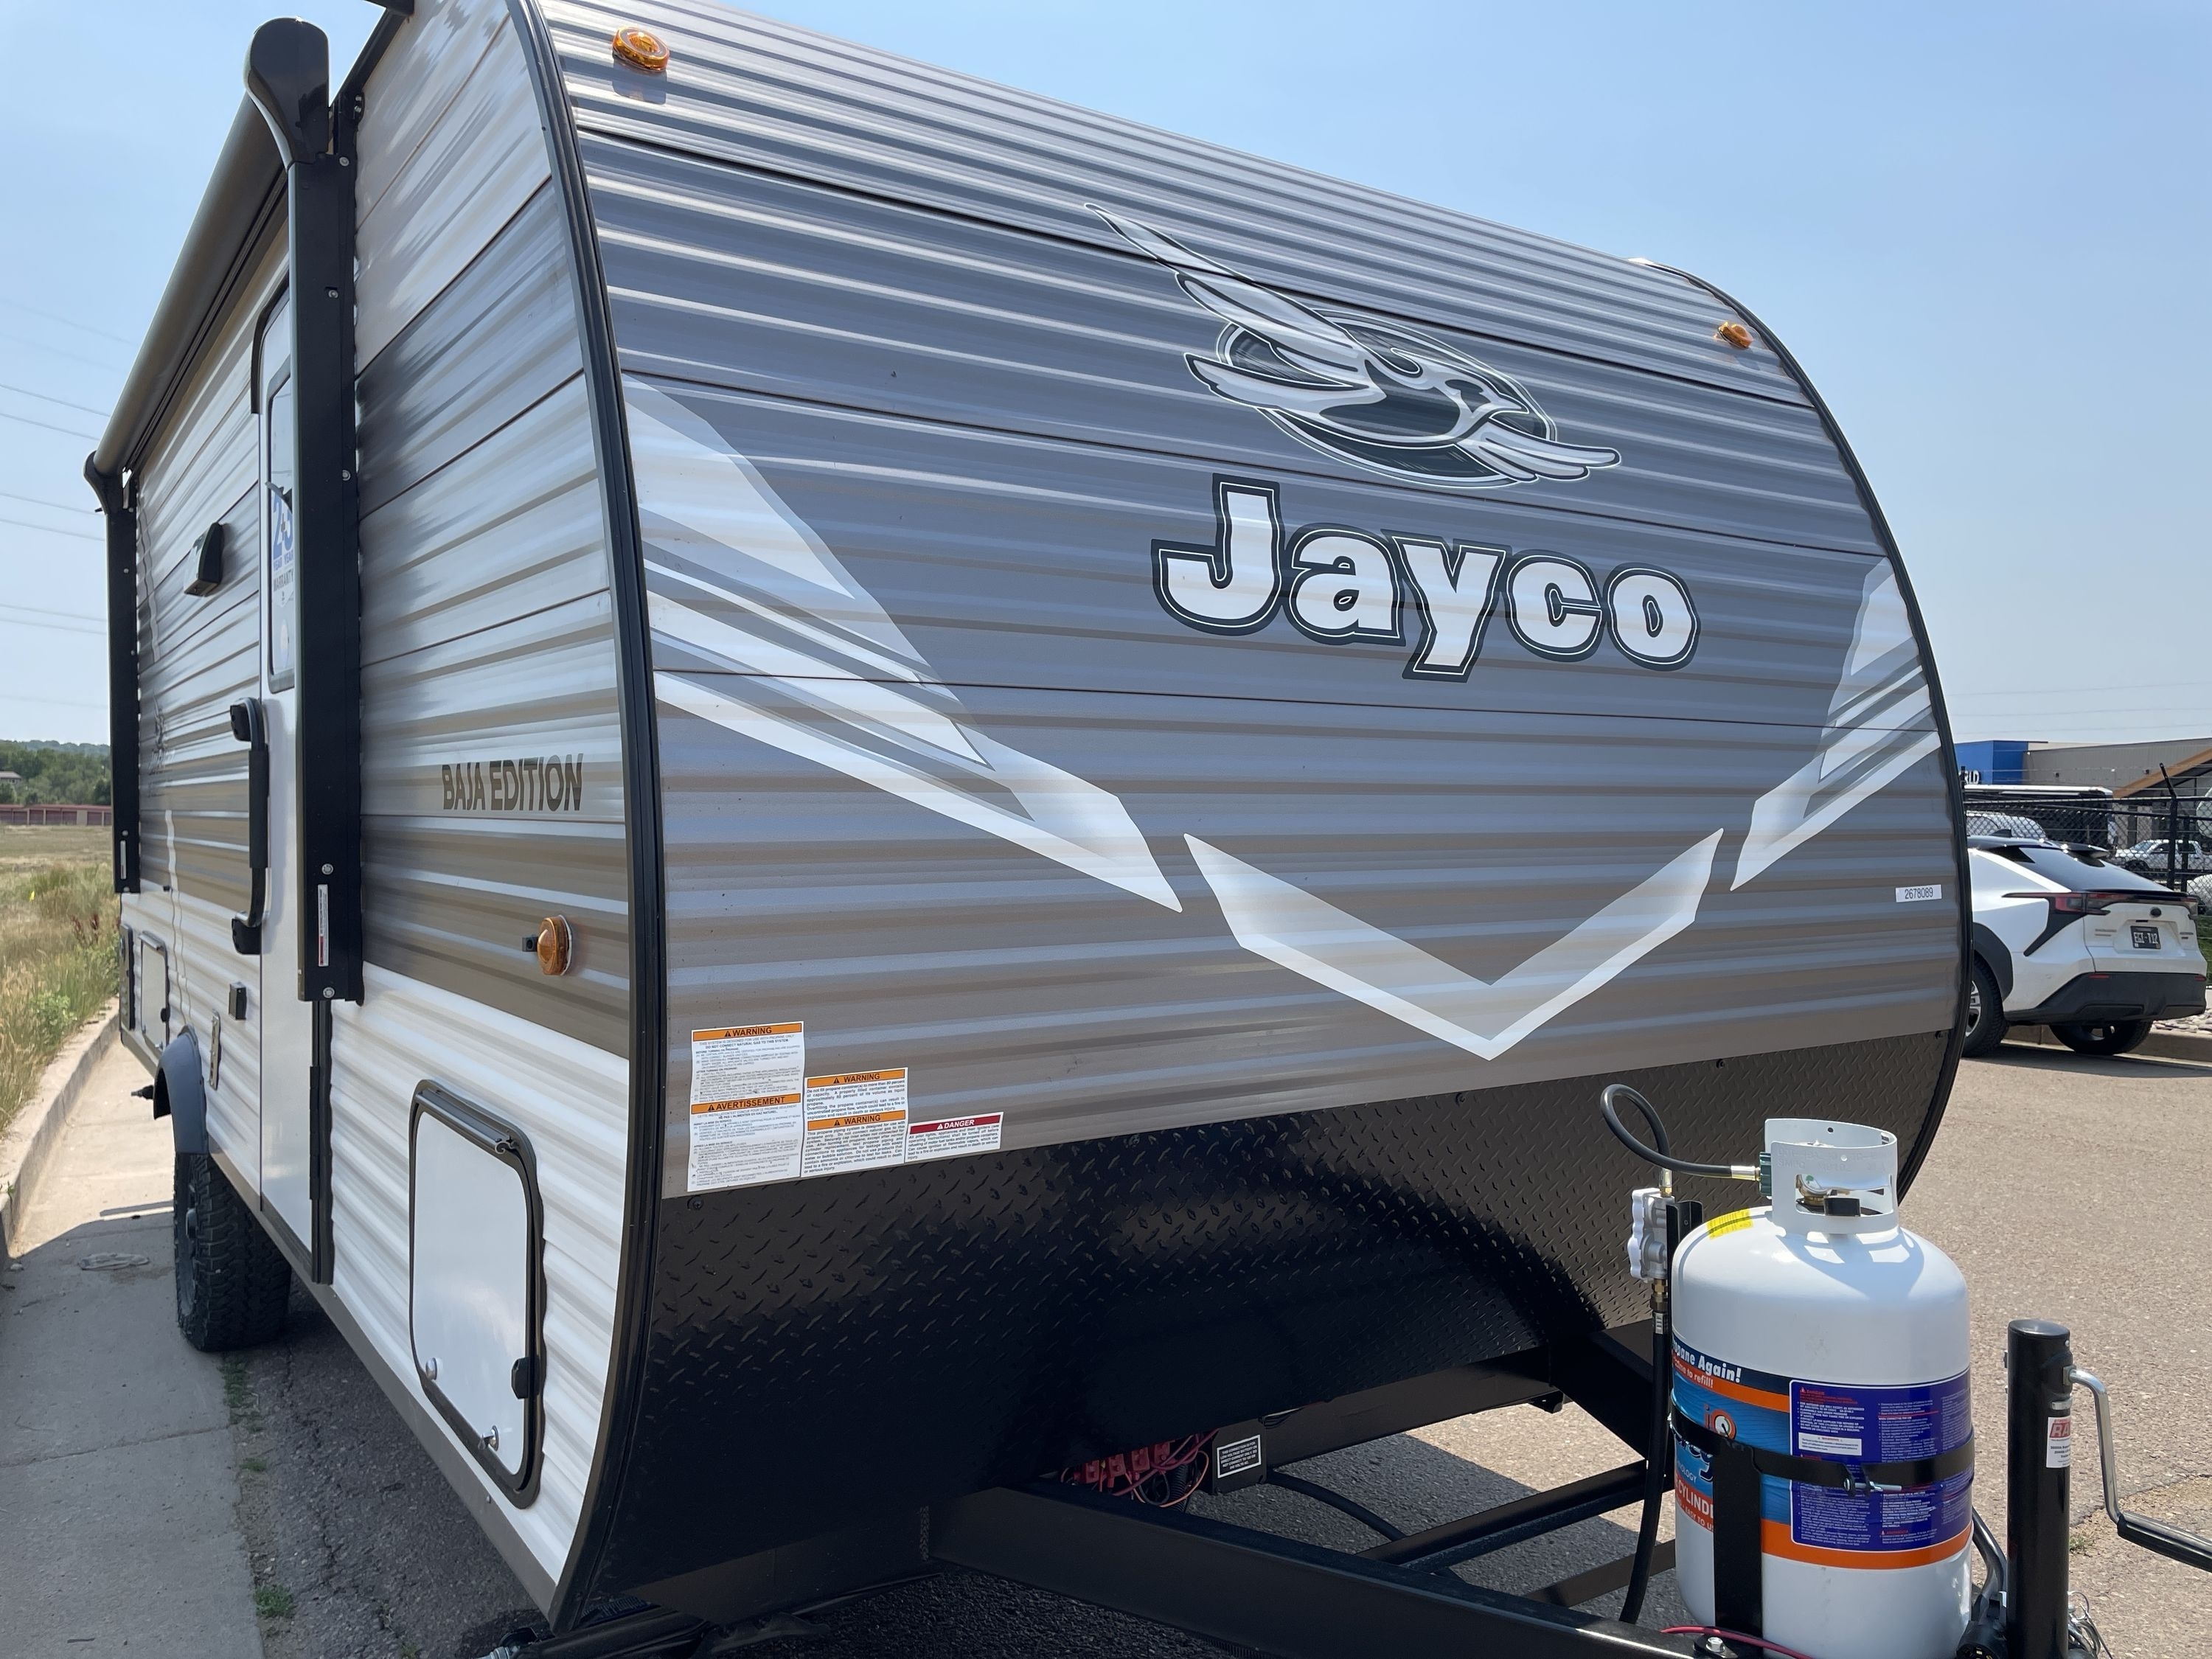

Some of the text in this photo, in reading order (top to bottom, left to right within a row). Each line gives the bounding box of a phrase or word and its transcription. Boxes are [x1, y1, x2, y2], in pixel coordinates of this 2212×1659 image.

[1152, 474, 1700, 682] Jayco
[442, 754, 583, 812] BAJA EDITION
[1905, 887, 1933, 900] 2678089
[733, 1027, 772, 1037] WARNING
[844, 1074, 880, 1082] WARNING
[844, 1115, 880, 1124] WARNING
[944, 1119, 975, 1129] DANGER
[1697, 1355, 1742, 1383] Again!
[1687, 1368, 1694, 1379] to
[1694, 1374, 1714, 1388] refill!
[2051, 1424, 2070, 1437] RA
[1678, 1479, 1714, 1519] CYLIND
[1697, 1516, 1705, 1526] TO
